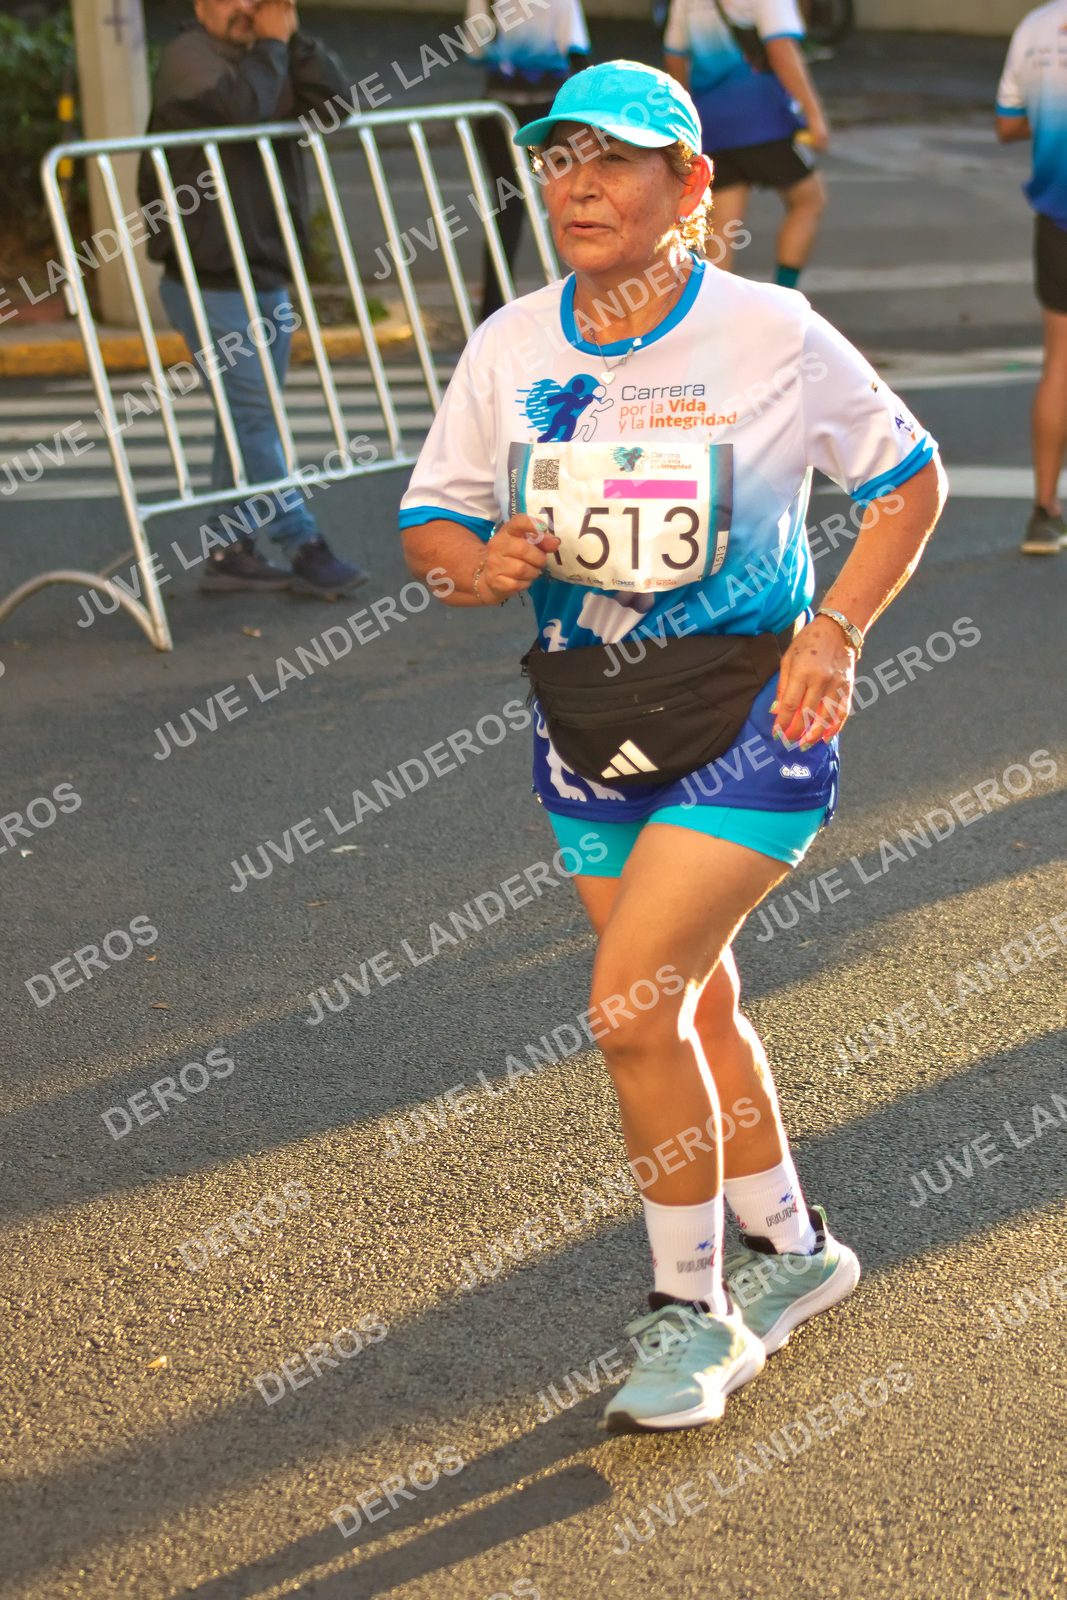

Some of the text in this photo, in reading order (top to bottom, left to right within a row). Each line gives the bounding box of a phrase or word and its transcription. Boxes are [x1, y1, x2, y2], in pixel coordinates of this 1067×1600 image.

[621, 384, 705, 400] Carrera
[620, 398, 706, 419] por la Vida
[619, 411, 737, 432] y la Integridad
[539, 506, 699, 570] 1513
[714, 545, 726, 567] 1513
